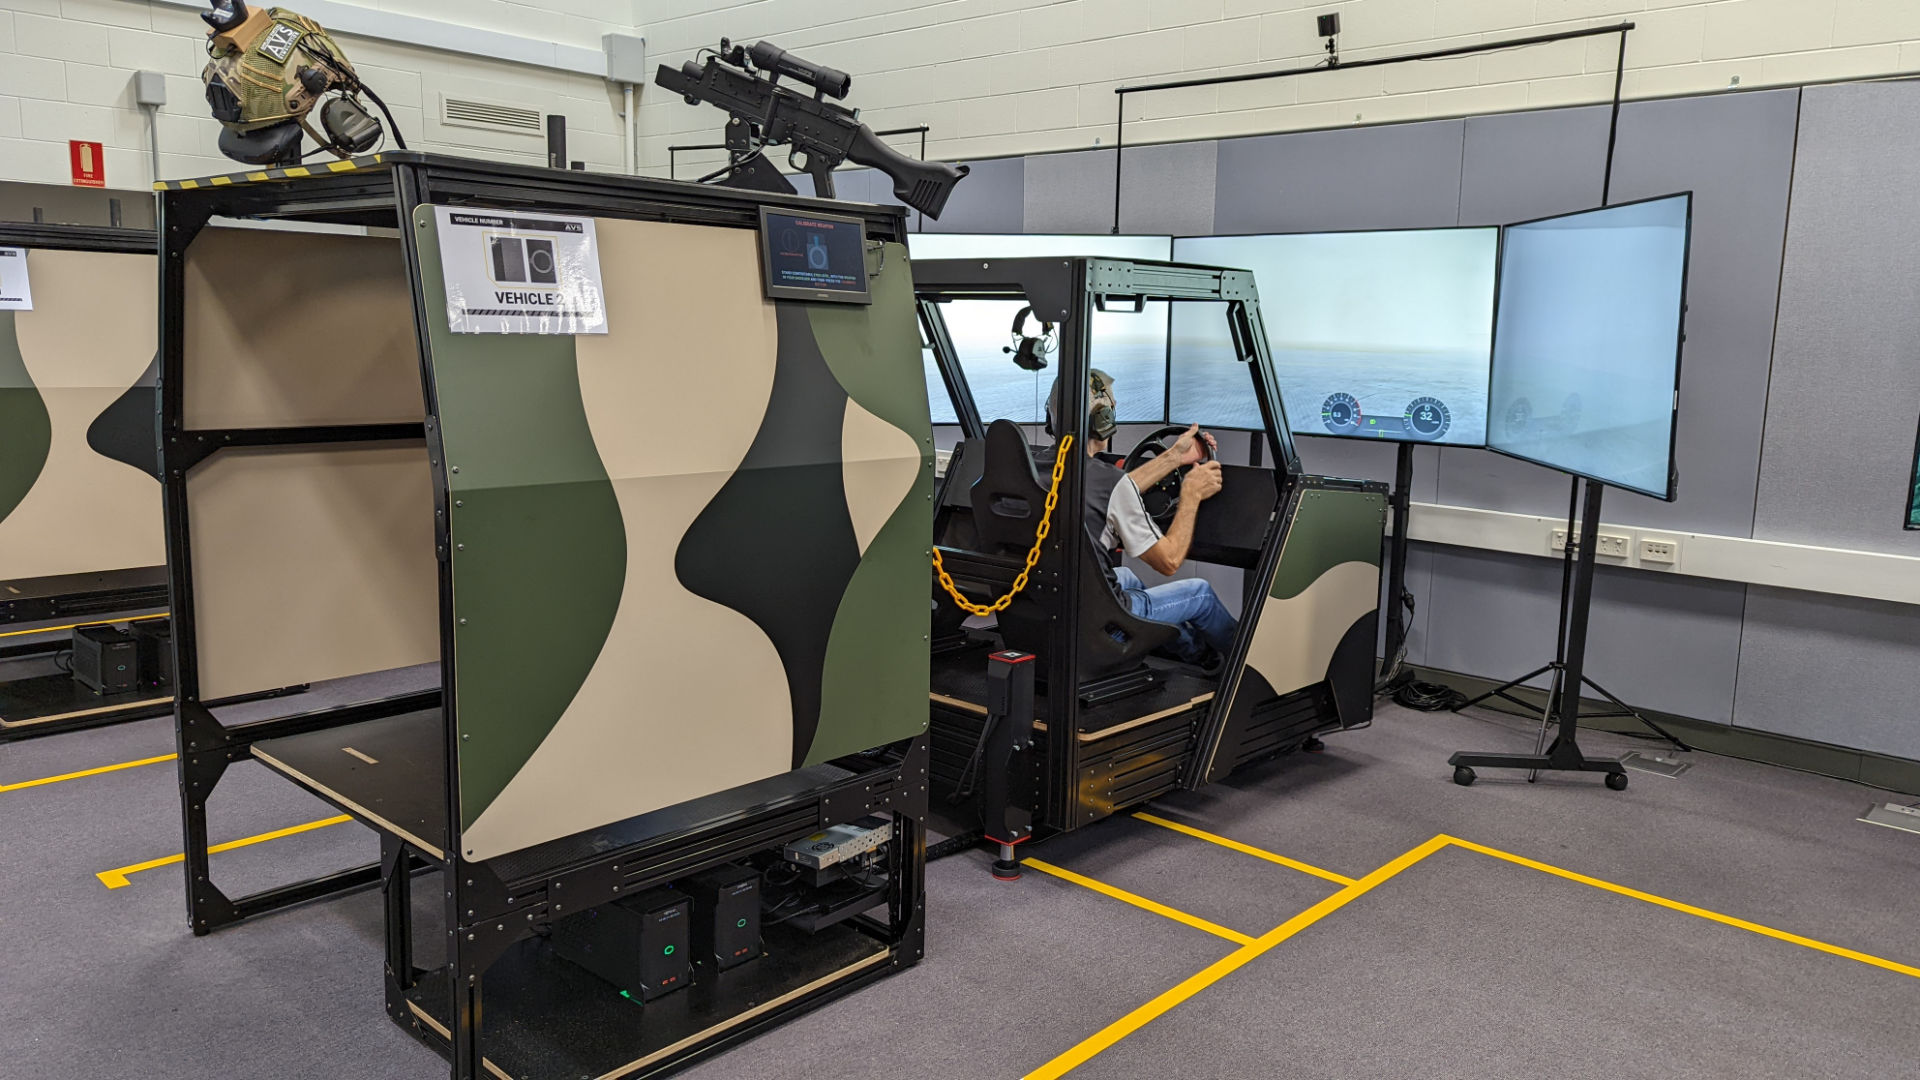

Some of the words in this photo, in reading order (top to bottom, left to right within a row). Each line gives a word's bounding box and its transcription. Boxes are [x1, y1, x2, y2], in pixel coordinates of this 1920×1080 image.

[268, 26, 293, 59] AVS
[454, 215, 478, 224] VEHICLE
[479, 217, 503, 226] NUMBER
[565, 223, 583, 232] AVS
[495, 291, 554, 306] VEHICLE
[556, 293, 566, 306] 2
[1420, 411, 1433, 421] 32
